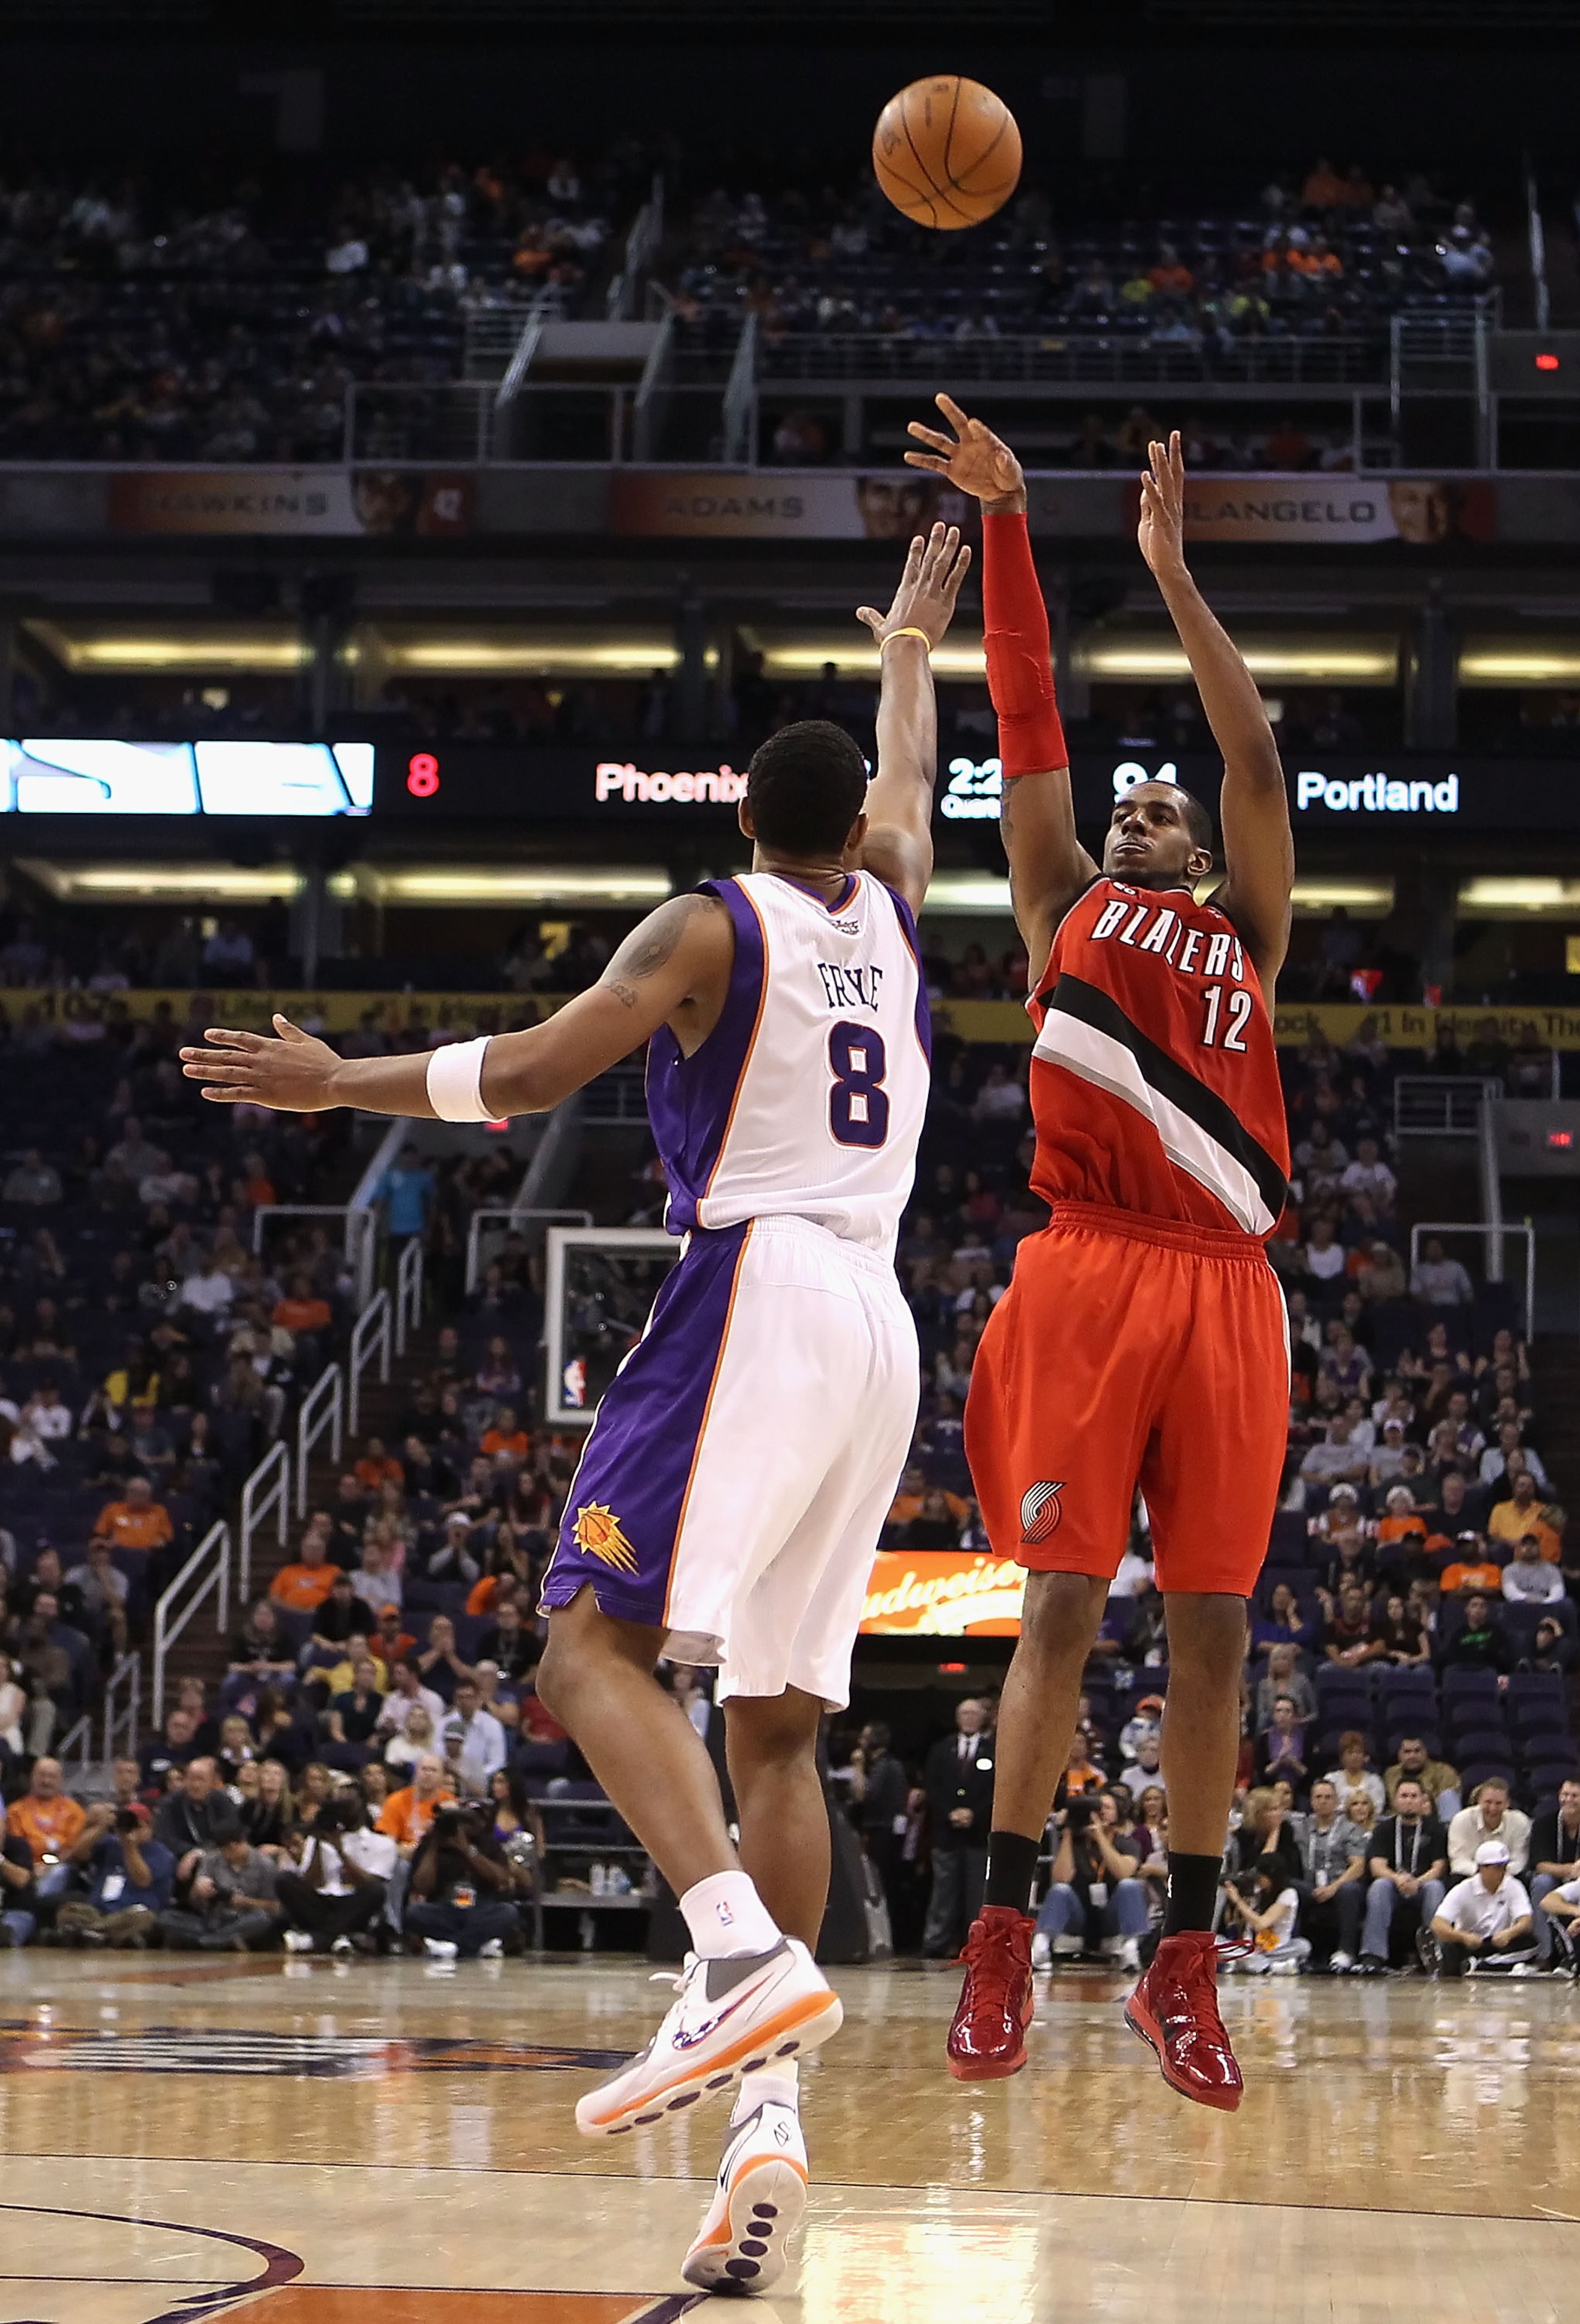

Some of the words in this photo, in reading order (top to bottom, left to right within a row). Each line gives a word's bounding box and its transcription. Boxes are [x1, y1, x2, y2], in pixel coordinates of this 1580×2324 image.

[665, 496, 804, 519] ADAMS
[1184, 499, 1377, 523] LANGELO
[406, 752, 440, 798] 8
[1297, 772, 1459, 812] Portland
[817, 962, 883, 1013] FRYE
[1204, 985, 1252, 1052] 12
[828, 1020, 891, 1149] 8
[860, 1556, 1029, 1622] udweise
